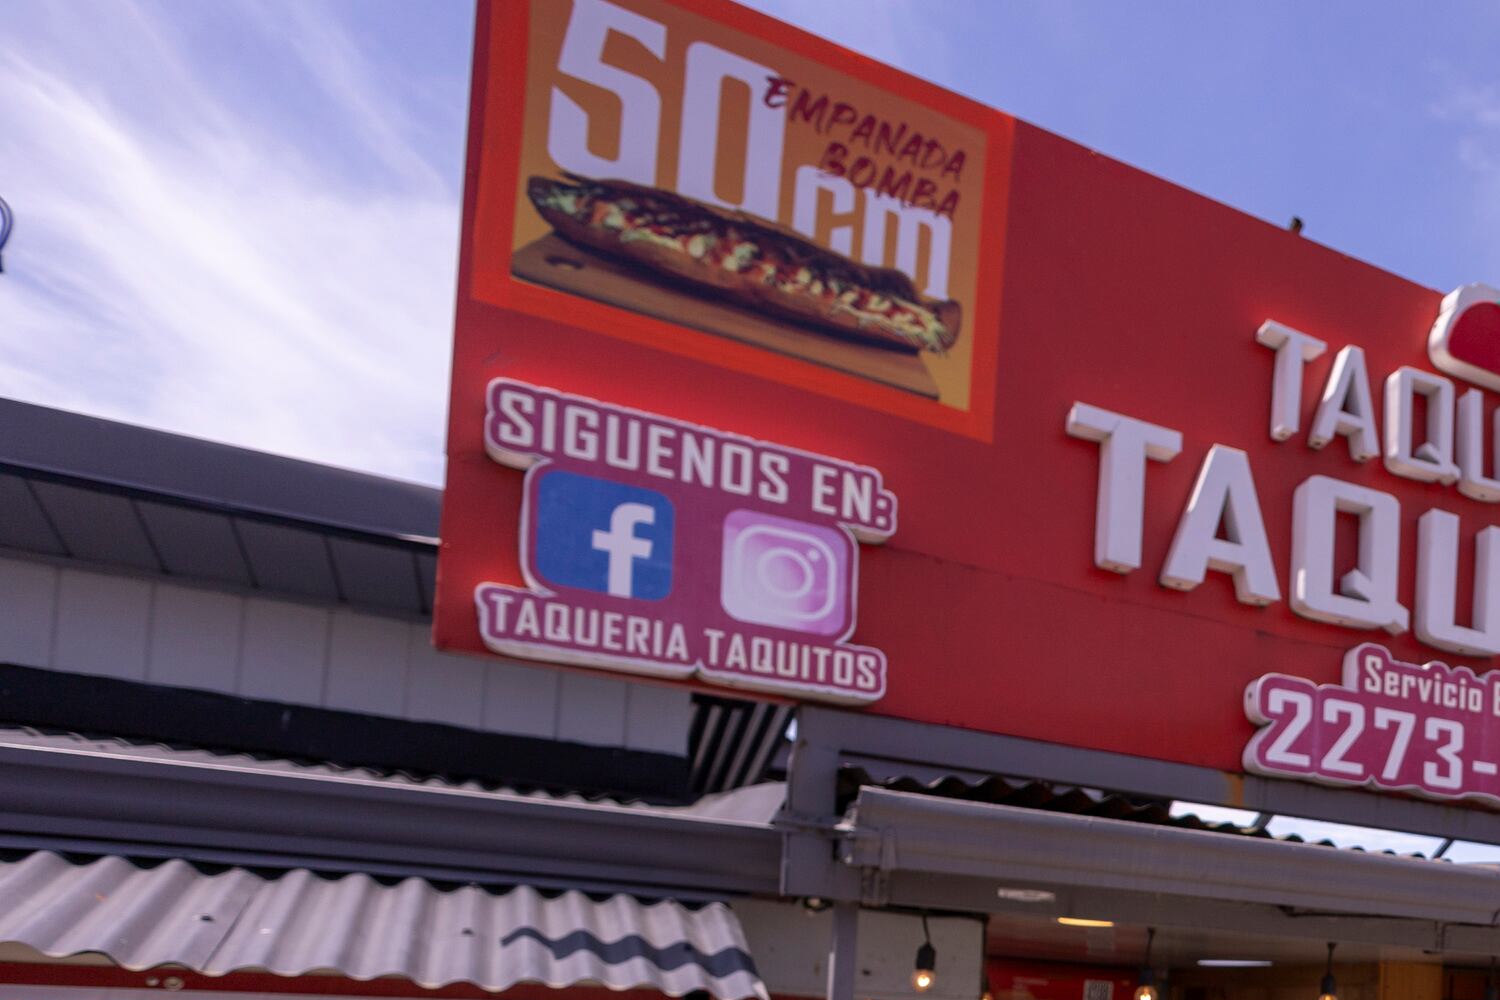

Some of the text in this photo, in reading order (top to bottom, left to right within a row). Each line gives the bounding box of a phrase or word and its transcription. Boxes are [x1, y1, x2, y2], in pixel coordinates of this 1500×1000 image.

[763, 75, 967, 182] EMPANADA
[818, 141, 961, 220] BOMBA
[499, 388, 888, 528] SIGUENOS EN:
[490, 592, 877, 692] TAQUERIA TAQUITOS
[1364, 656, 1482, 713] Servicio
